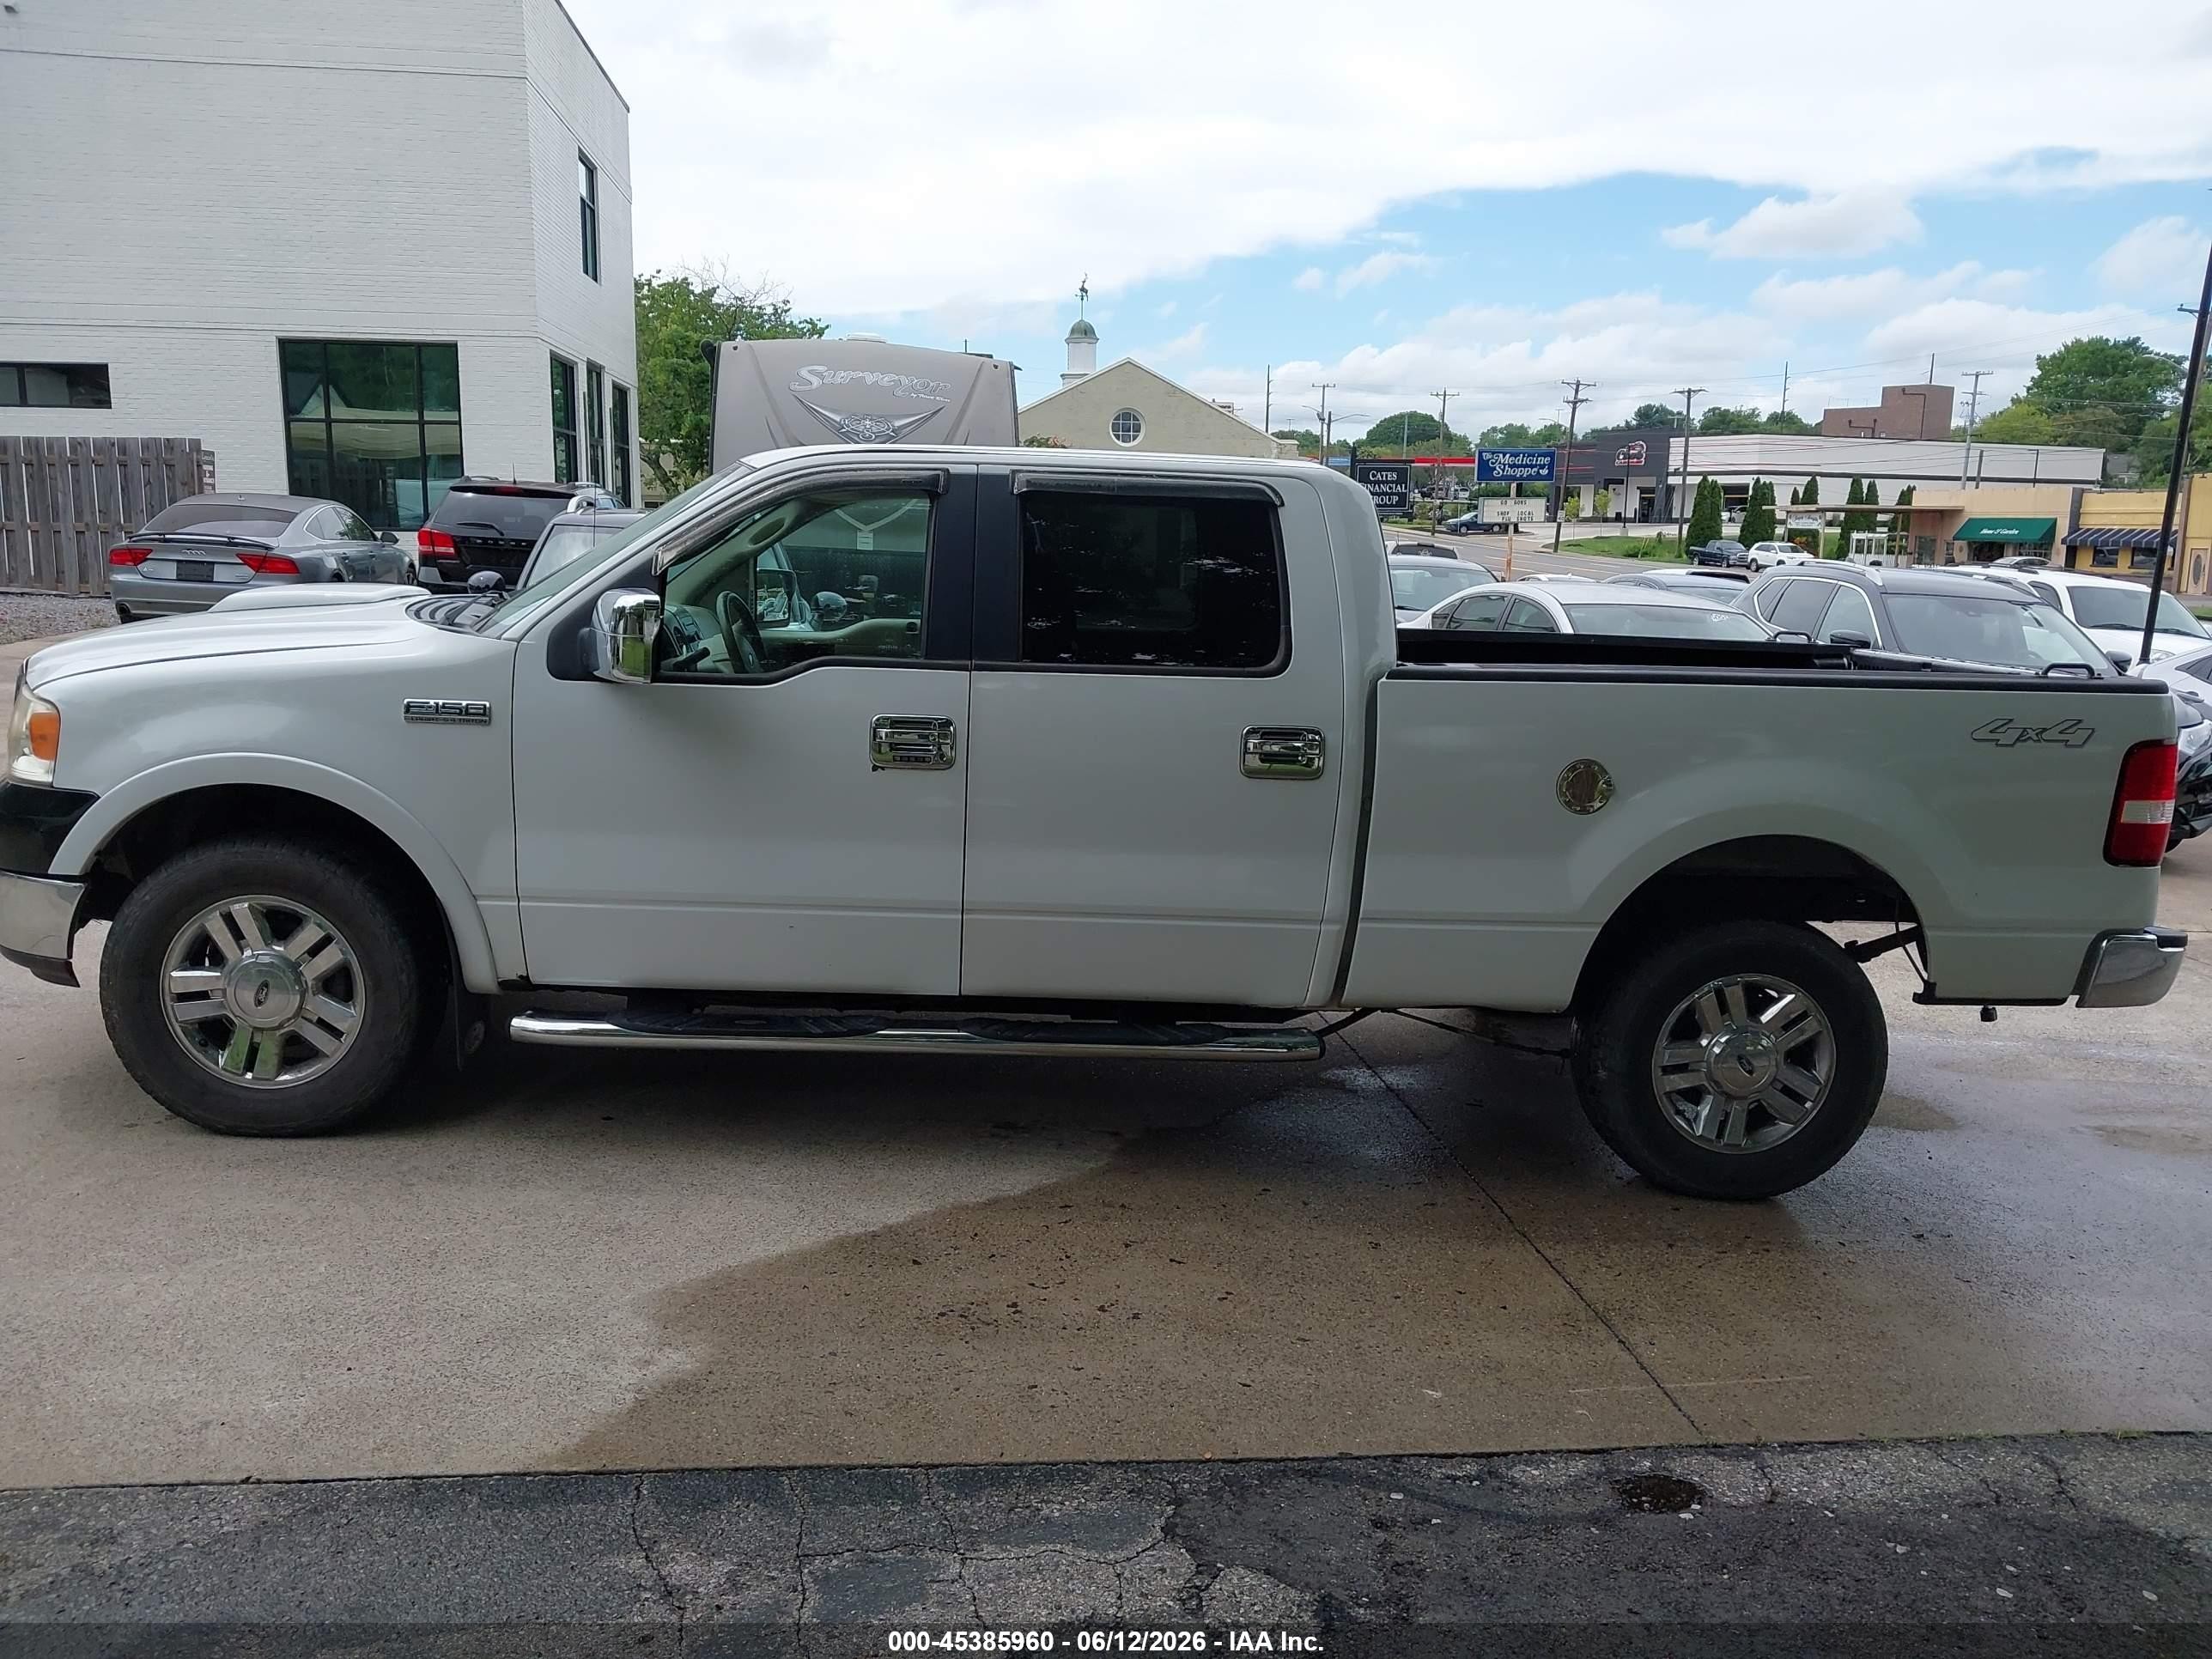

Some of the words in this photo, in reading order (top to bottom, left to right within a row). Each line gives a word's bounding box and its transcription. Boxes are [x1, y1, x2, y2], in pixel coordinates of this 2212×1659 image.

[789, 365, 951, 398] Surveyor
[1489, 453, 1551, 466] Medicine
[1369, 470, 1398, 481] CATES
[1493, 465, 1537, 477] Shoppe
[1373, 495, 1399, 505] ROUP
[1971, 718, 2095, 748] 4x4
